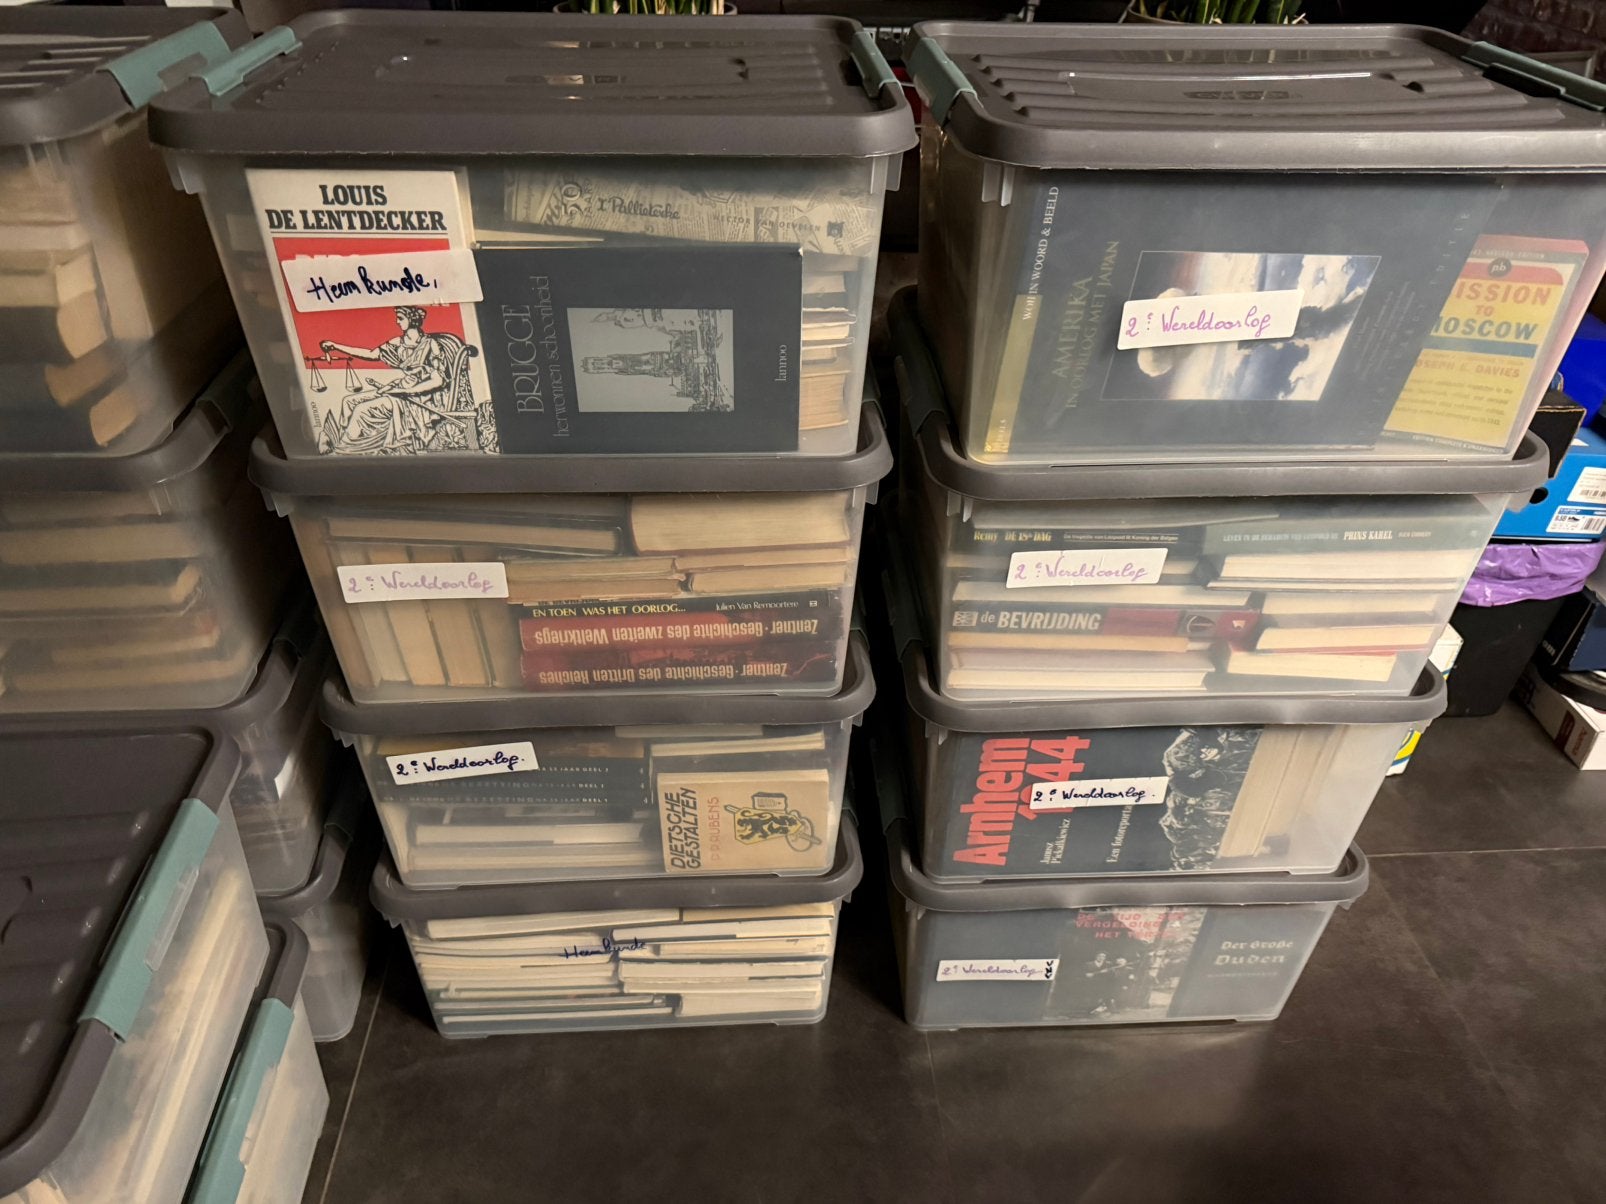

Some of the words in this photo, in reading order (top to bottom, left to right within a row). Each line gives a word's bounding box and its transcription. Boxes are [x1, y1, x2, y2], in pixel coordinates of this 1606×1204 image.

[319, 185, 387, 205] LOUIS
[1042, 186, 1060, 226] BEELD
[265, 209, 297, 230] DE
[302, 210, 447, 231] LENTDECKER
[1040, 227, 1051, 237] &
[1031, 238, 1051, 281] WOORD
[1095, 239, 1120, 288] JAPAN
[1455, 281, 1551, 306] ISSION
[1087, 292, 1105, 324] MET
[1475, 304, 1496, 317] TO
[529, 275, 560, 362] schoonheid
[1051, 276, 1093, 379] AMERIKA
[502, 304, 544, 414] BRUGGE
[774, 344, 787, 382] lannoo
[1070, 327, 1098, 392] OORLOG
[1415, 359, 1456, 371] OSEPH
[1475, 363, 1520, 378] DAVIES
[547, 364, 570, 438] herwonnen
[533, 608, 547, 617] EN
[550, 607, 577, 617] TOEN
[582, 606, 606, 616] WAS
[608, 605, 627, 615] HET
[737, 601, 752, 610] Van
[698, 621, 763, 638] Geschichte
[981, 612, 996, 623] de
[997, 611, 1102, 631] BEVRIJDING
[535, 628, 609, 645] Weltkriegs
[612, 626, 663, 642] zweiten
[667, 624, 691, 639] des
[540, 669, 589, 685] Reiches
[593, 667, 636, 682] Dritten
[639, 667, 662, 680] des
[666, 664, 735, 679] Geschichte
[953, 738, 1031, 866] Arnhem
[664, 791, 687, 869] DIETSCHE
[680, 787, 702, 869] GESTALTEN
[1110, 804, 1134, 847] fotoreporta
[1221, 941, 1248, 951] Der
[1215, 954, 1286, 966] Duden
